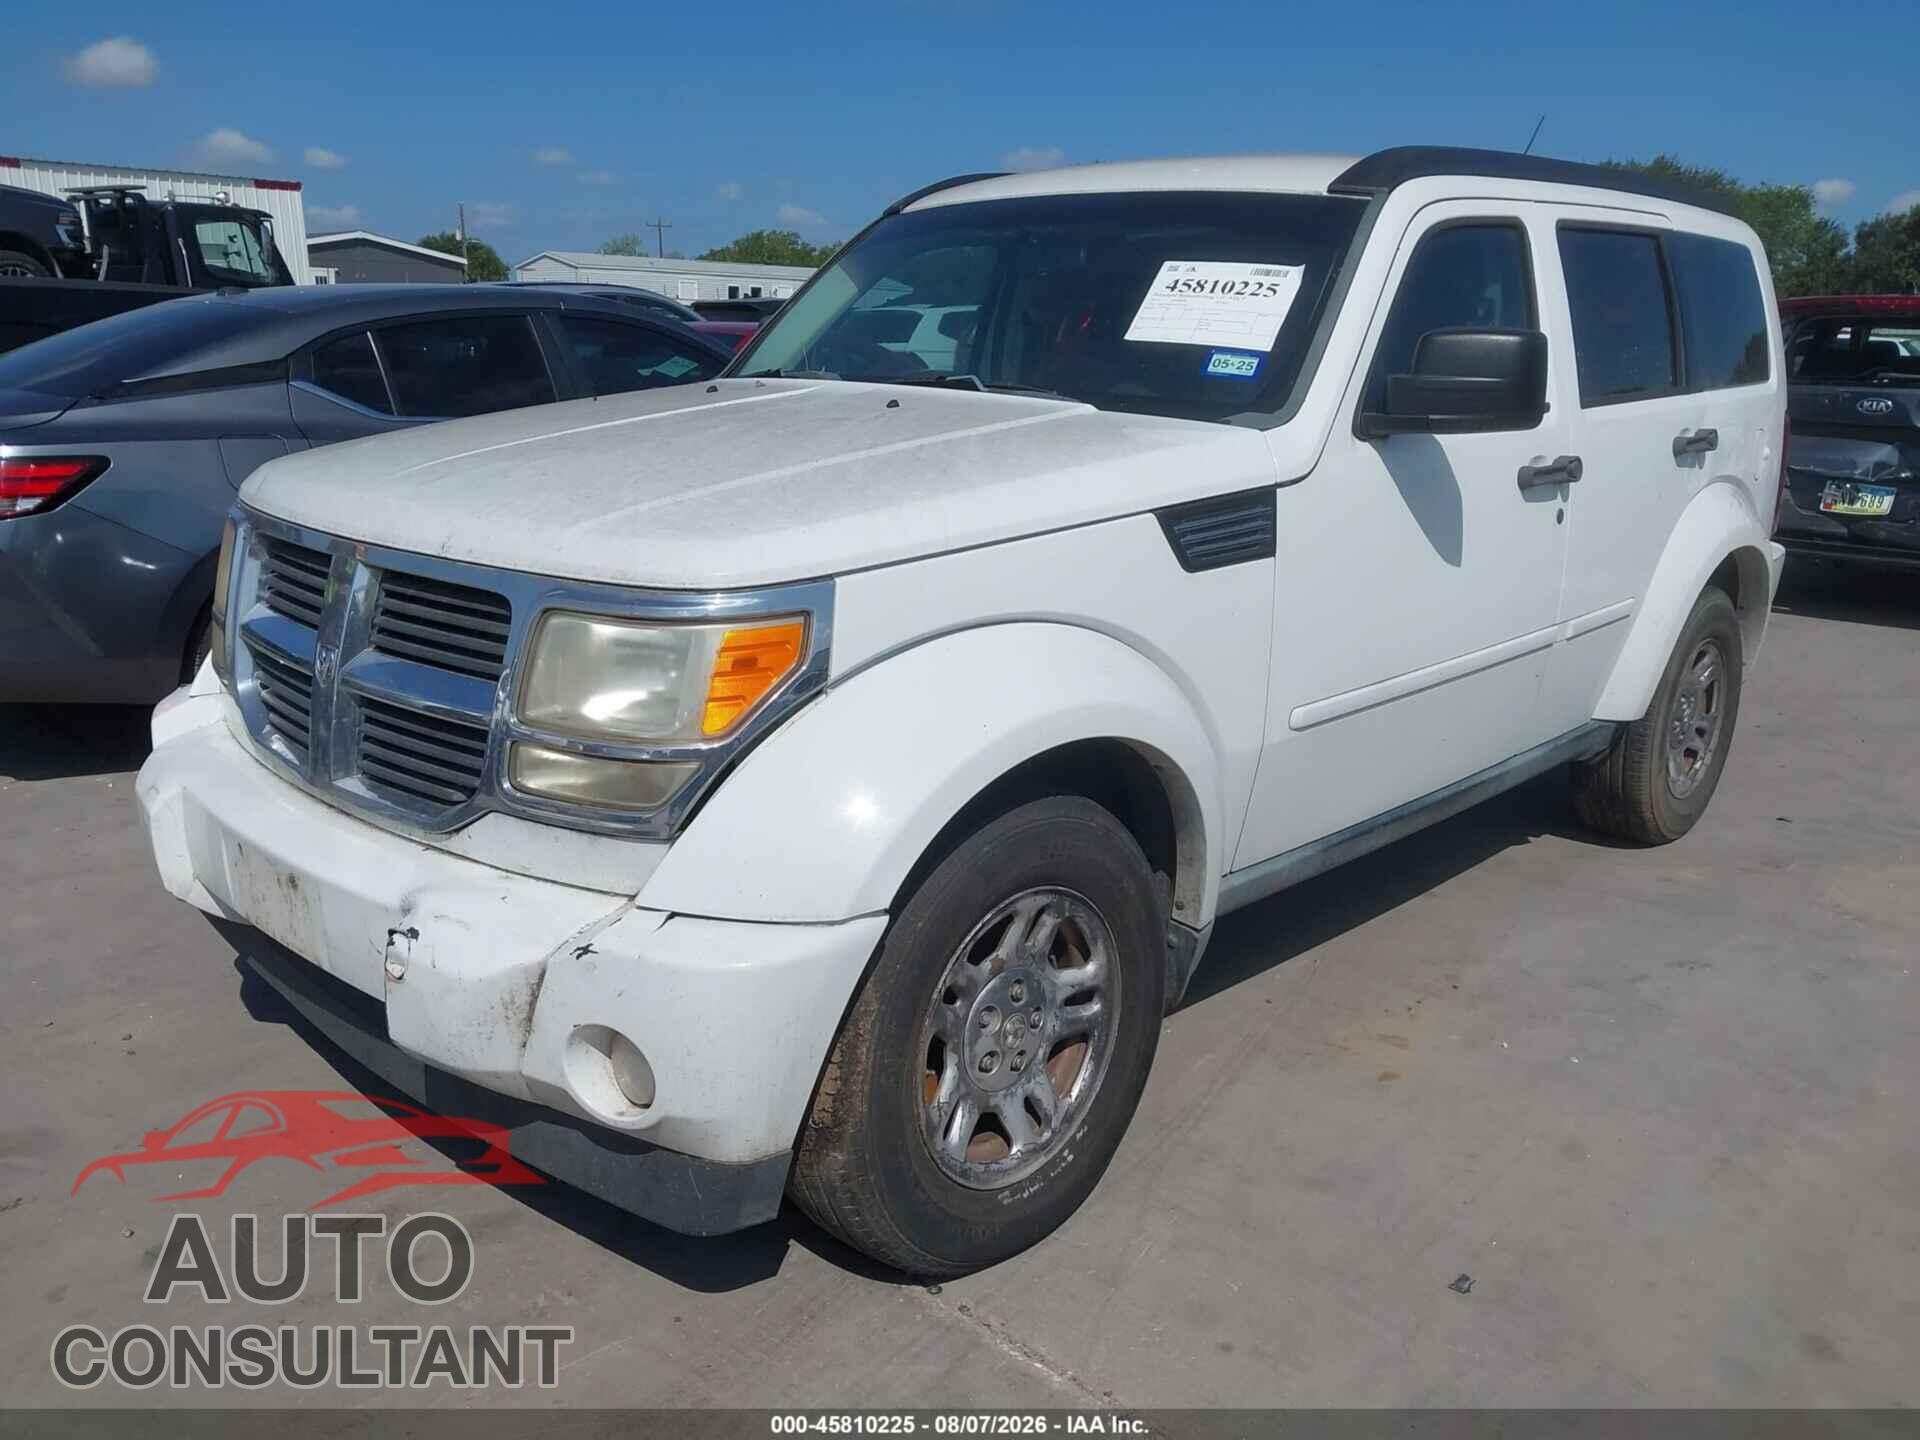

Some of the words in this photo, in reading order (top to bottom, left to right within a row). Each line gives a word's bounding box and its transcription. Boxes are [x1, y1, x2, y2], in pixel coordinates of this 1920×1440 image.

[1165, 278, 1281, 298] 45810225
[1212, 358, 1231, 369] 05
[1235, 360, 1255, 371] 25
[1862, 400, 1887, 412] KIA
